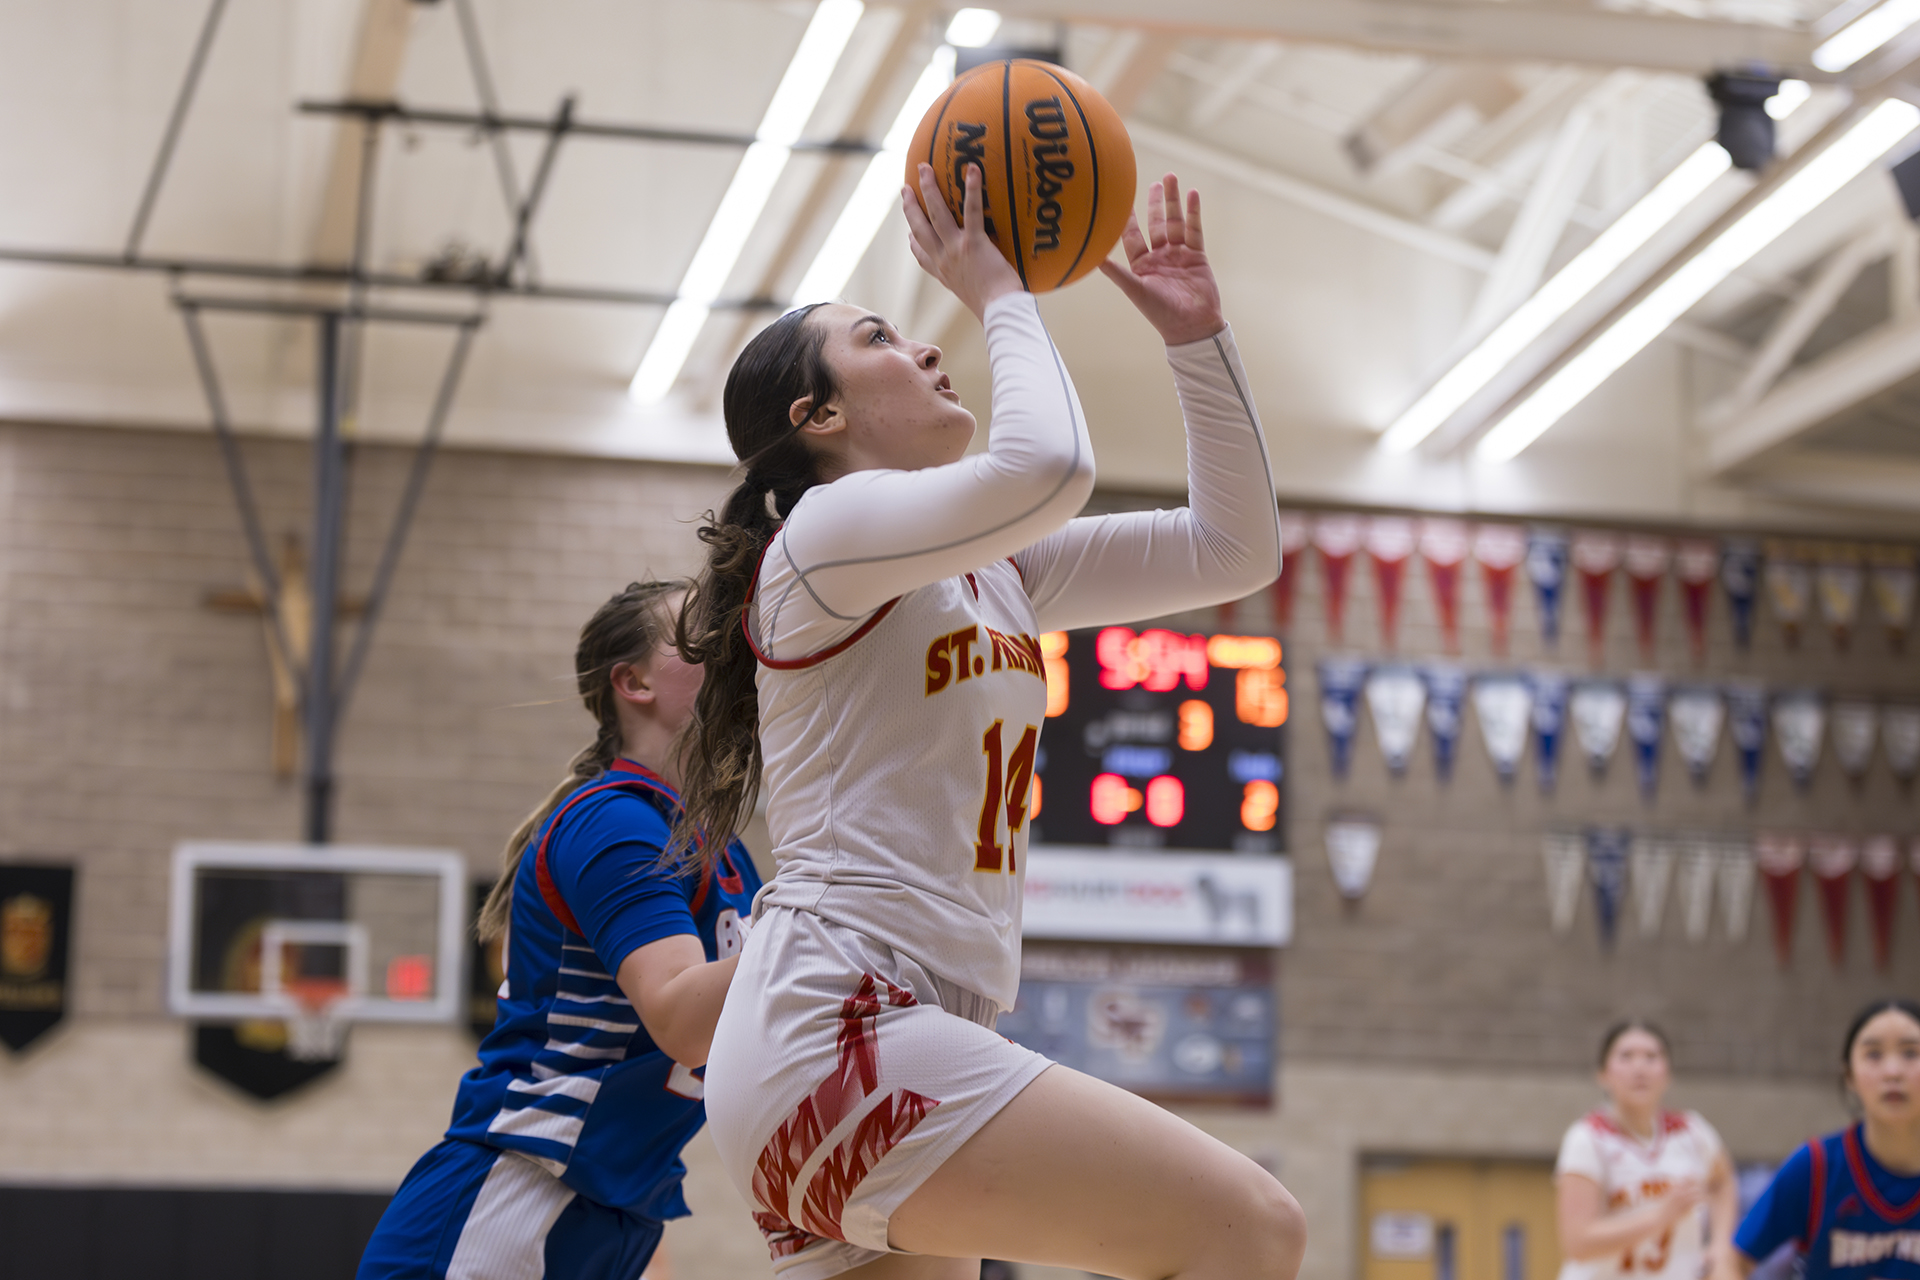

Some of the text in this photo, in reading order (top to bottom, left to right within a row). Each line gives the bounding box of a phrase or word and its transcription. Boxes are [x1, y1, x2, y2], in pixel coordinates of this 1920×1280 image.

[955, 121, 998, 238] NC
[1024, 95, 1074, 259] Wilson
[925, 622, 985, 697] ST.
[973, 717, 1038, 876] 14
